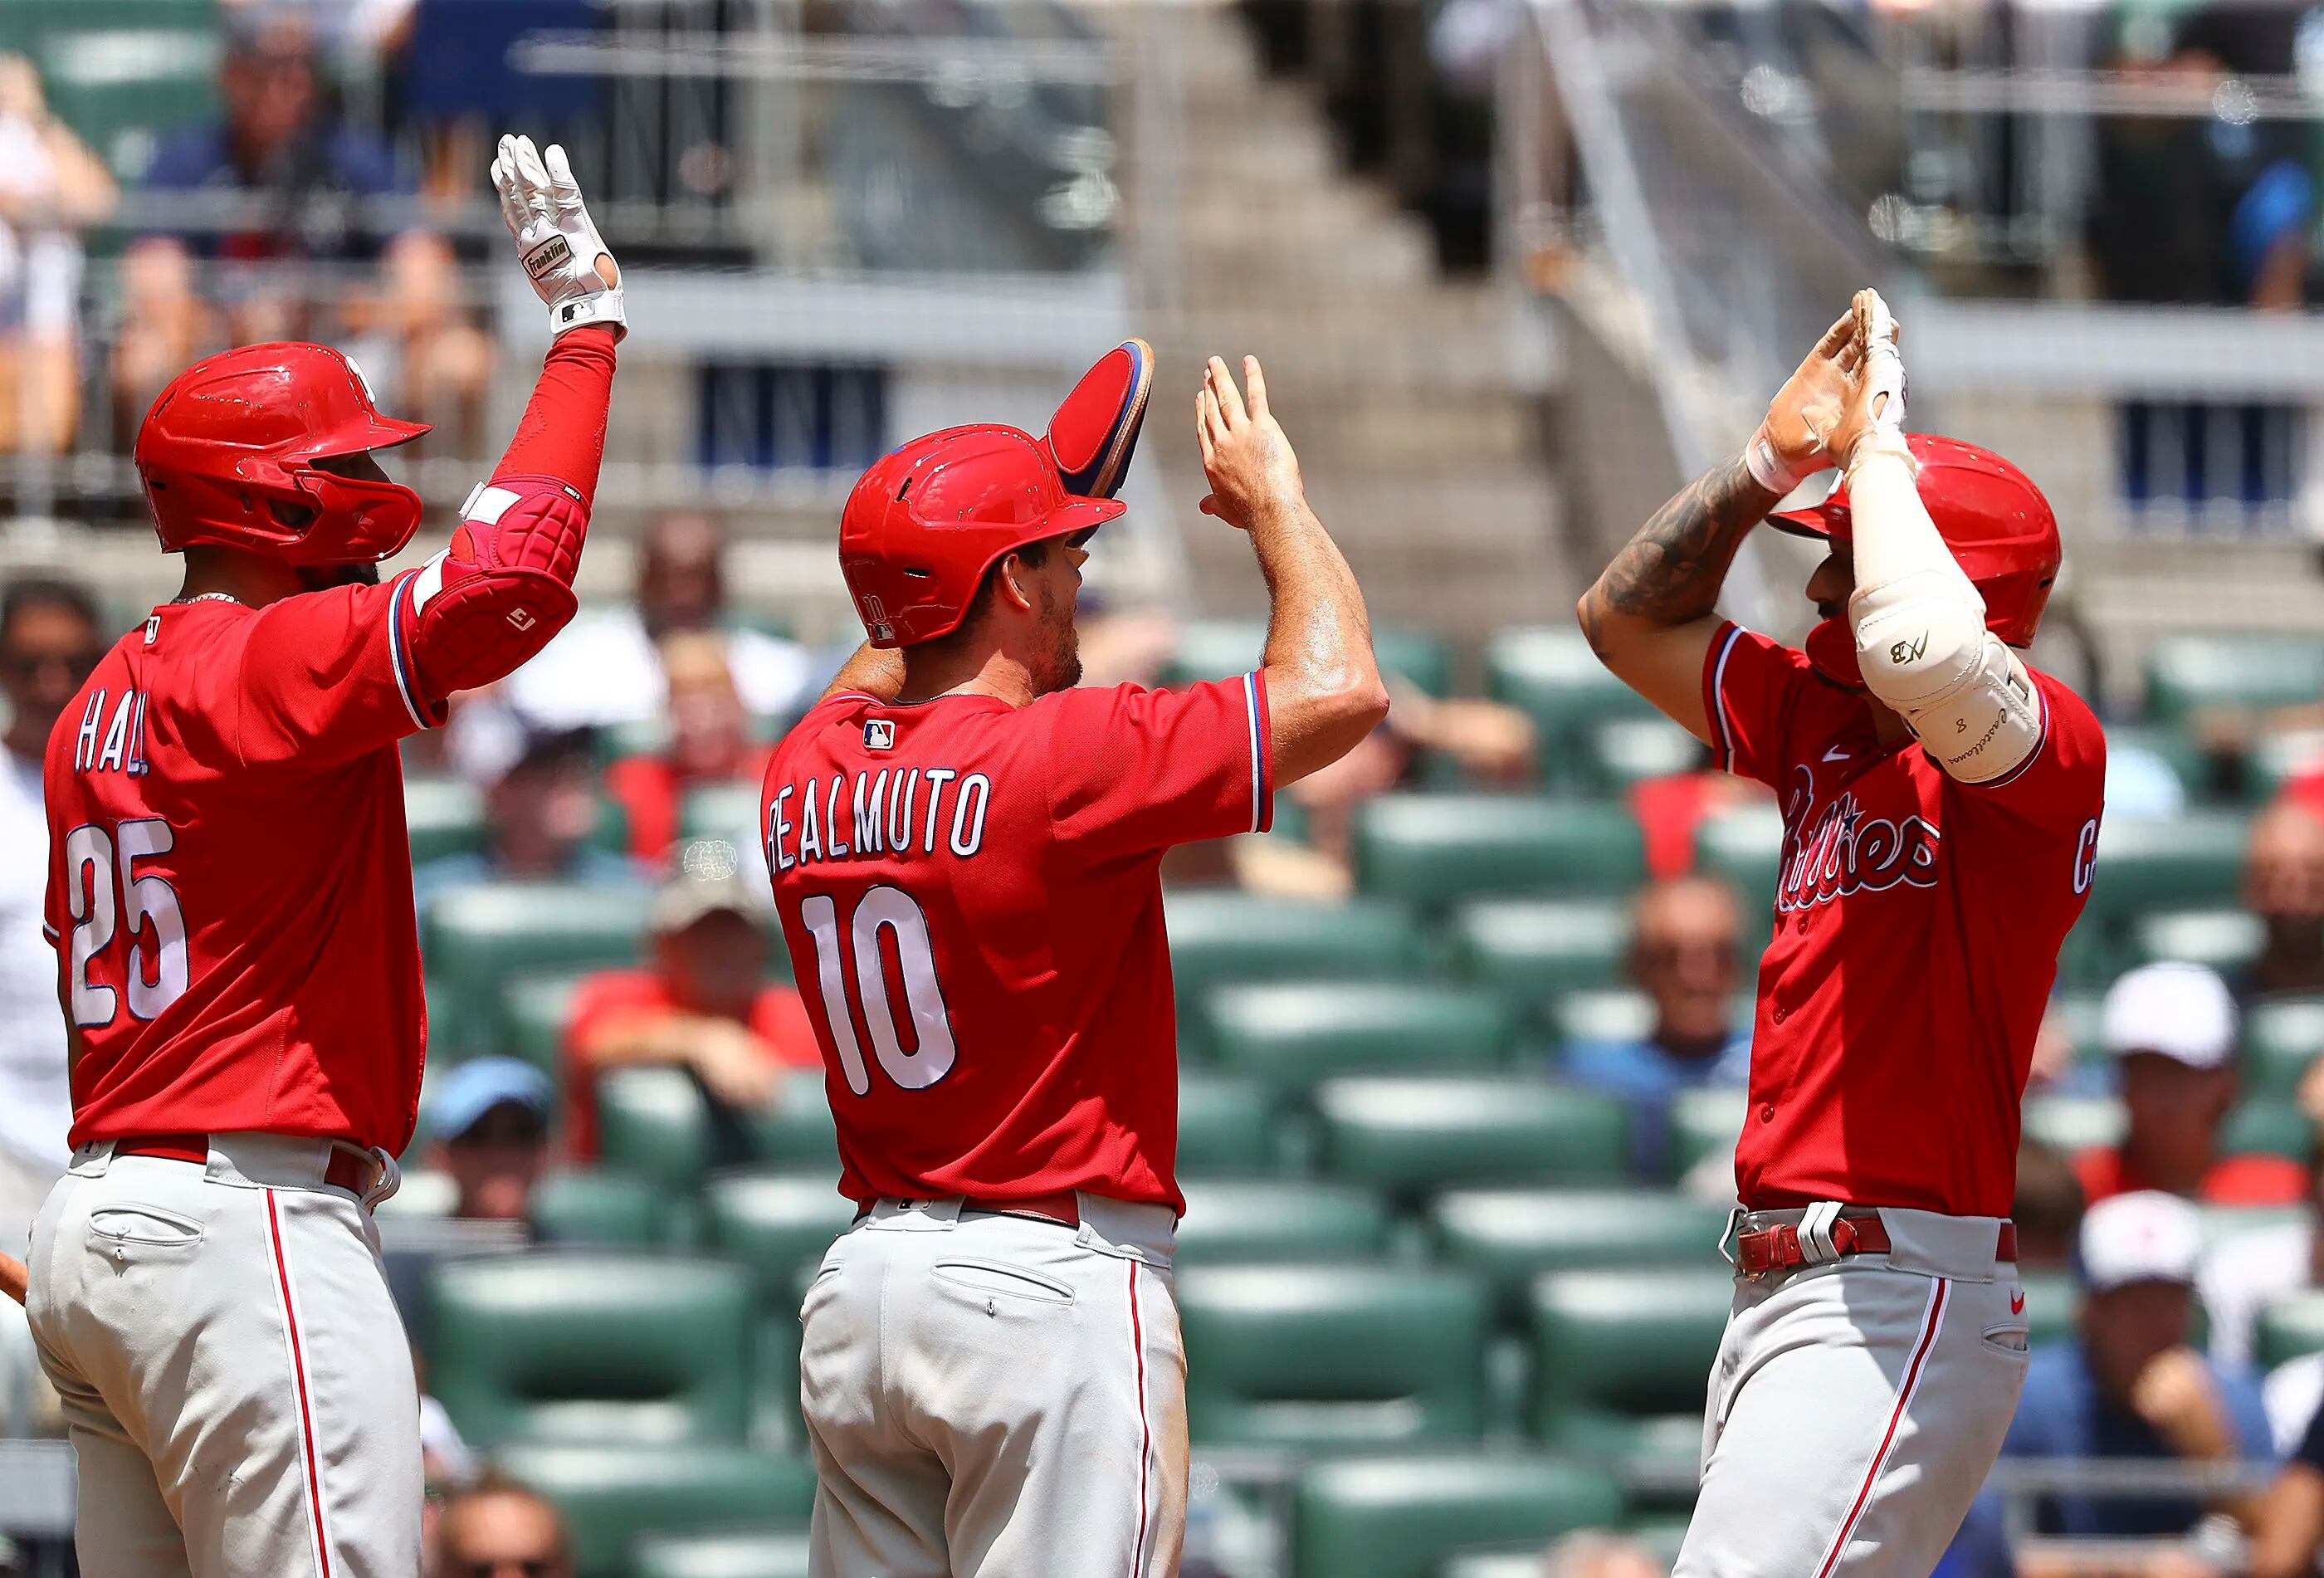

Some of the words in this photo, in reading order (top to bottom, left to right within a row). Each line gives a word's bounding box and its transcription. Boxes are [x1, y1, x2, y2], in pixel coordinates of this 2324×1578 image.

[527, 242, 566, 276] Franklin
[1955, 718, 1967, 734] 8
[767, 767, 991, 875] REALMUTO
[66, 817, 189, 1026] 25
[800, 883, 955, 1096] 10
